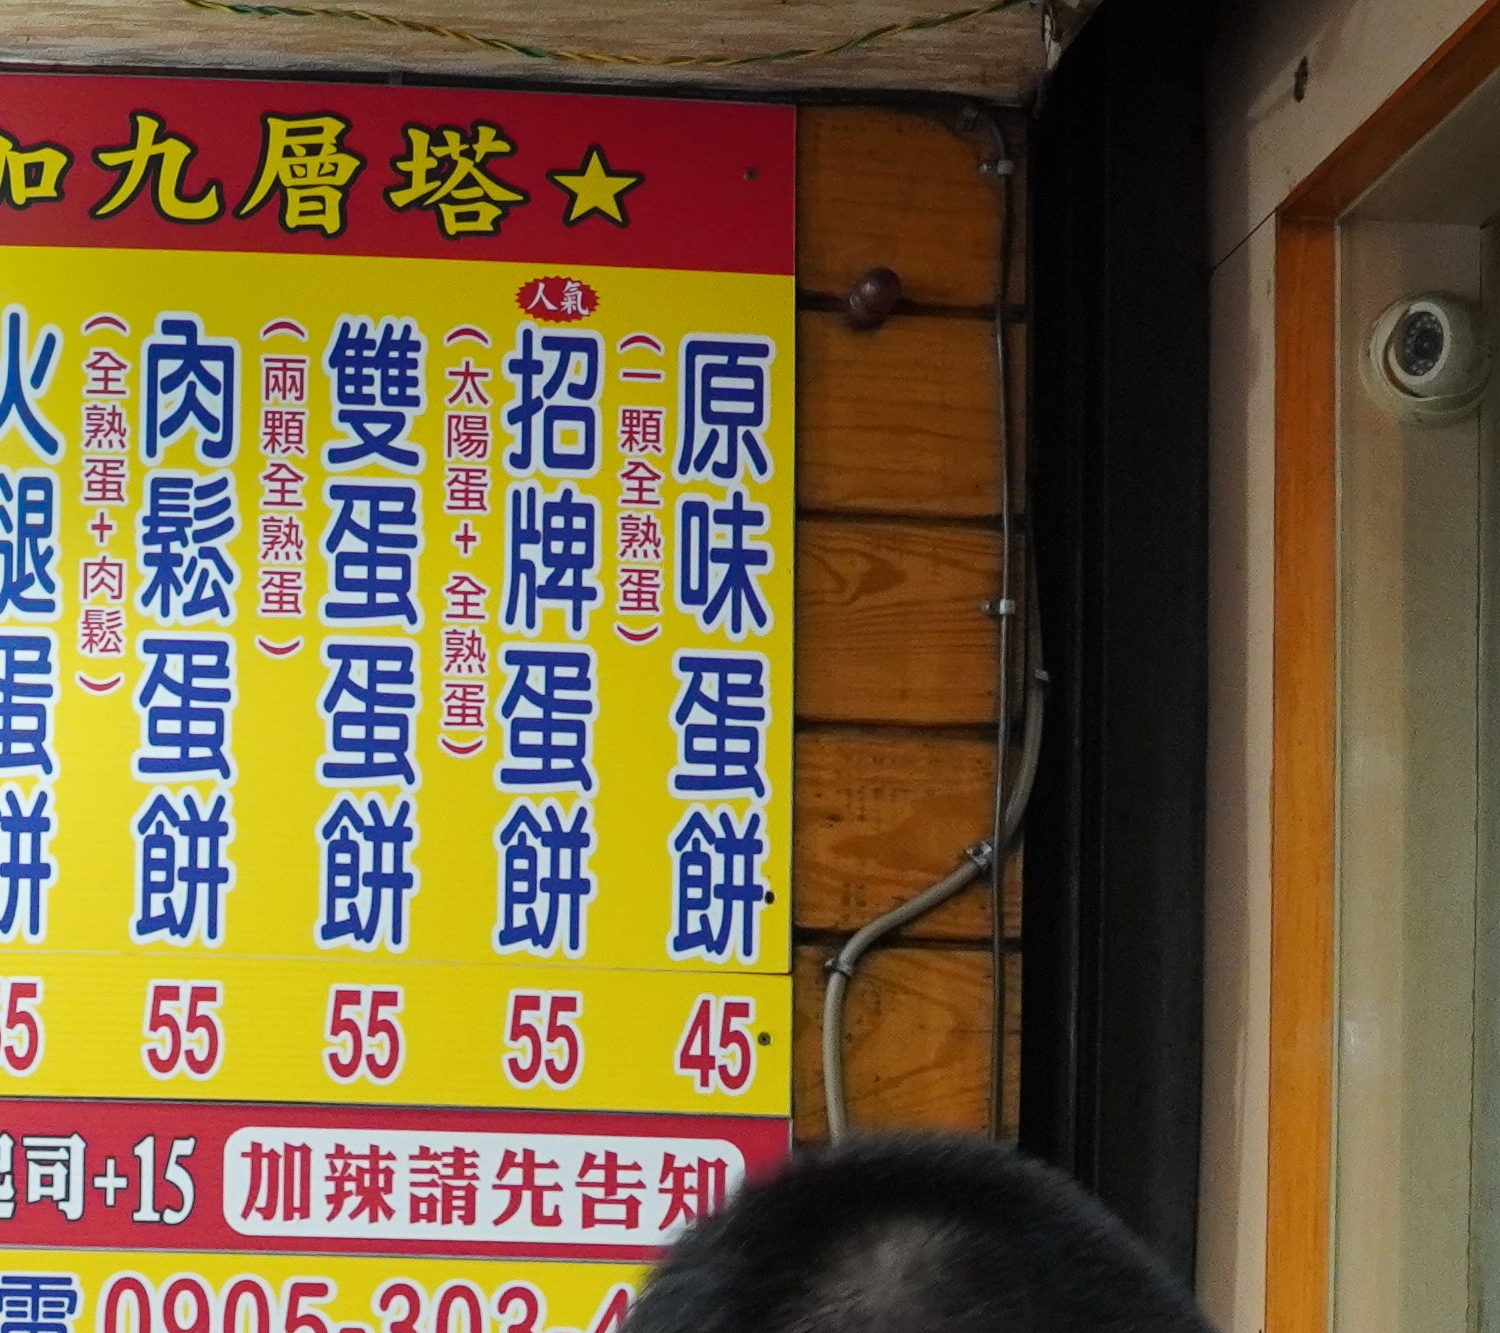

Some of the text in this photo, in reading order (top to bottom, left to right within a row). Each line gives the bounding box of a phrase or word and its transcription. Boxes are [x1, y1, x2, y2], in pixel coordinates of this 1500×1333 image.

[528, 281, 592, 316] 人氣
[136, 318, 236, 941] 肉鬆蛋餅
[320, 322, 422, 946] 雙蛋蛋餅
[498, 327, 600, 951] 招牌蛋餅
[672, 340, 771, 958] 原味蛋餅
[145, 984, 221, 1076] 55
[327, 988, 401, 1080] 55
[507, 992, 579, 1086] 55
[679, 998, 752, 1091] 45
[240, 1141, 728, 1233] 加辣請先告知
